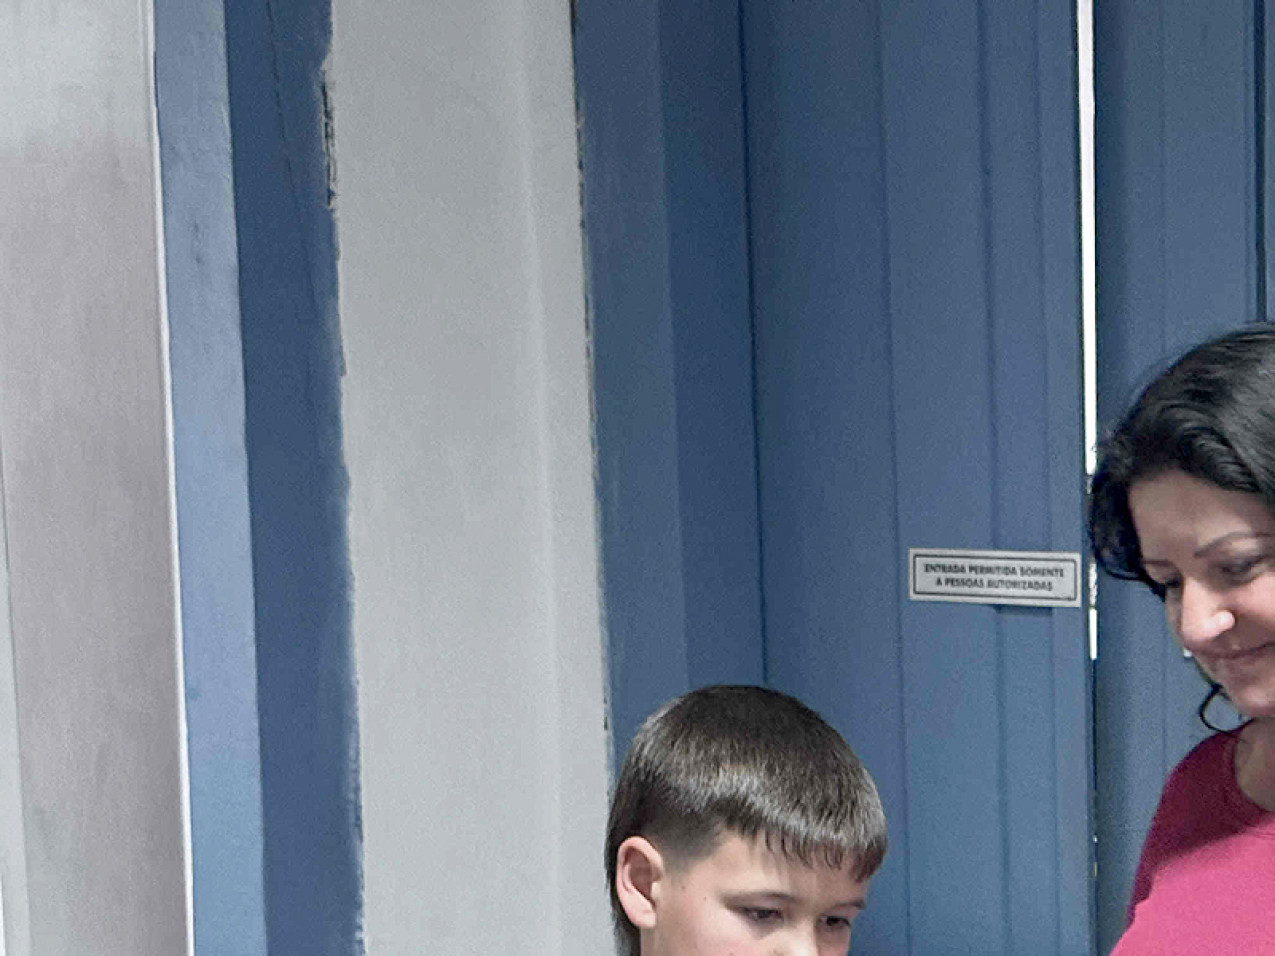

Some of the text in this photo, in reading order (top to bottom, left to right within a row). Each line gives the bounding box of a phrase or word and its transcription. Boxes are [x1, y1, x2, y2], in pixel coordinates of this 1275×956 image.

[924, 563, 1064, 578] ENTRADA PERMITIDA SOMENTE
[936, 577, 1053, 591] A PESSOAS AUTORIZADAS
